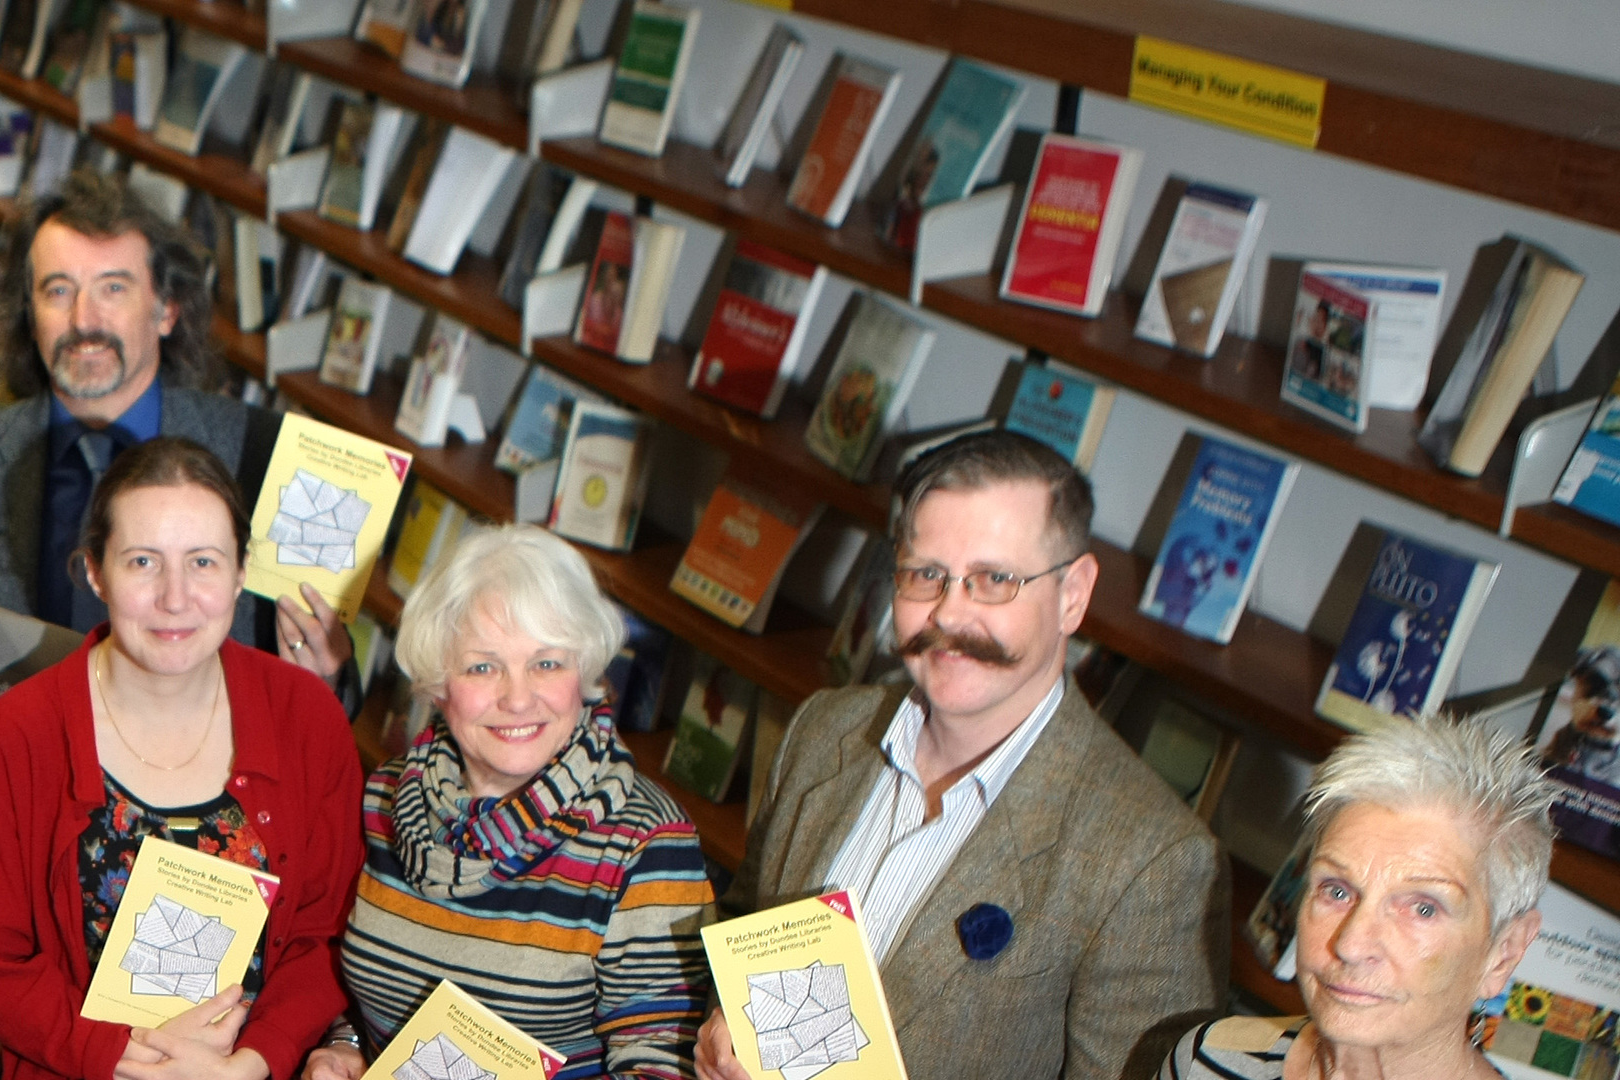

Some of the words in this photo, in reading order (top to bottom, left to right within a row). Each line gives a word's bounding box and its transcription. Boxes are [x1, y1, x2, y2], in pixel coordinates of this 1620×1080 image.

[1138, 56, 1204, 94] Managing
[1208, 72, 1240, 99] Your
[1243, 81, 1318, 118] Condition
[1197, 478, 1252, 512] Memory
[1380, 542, 1415, 574] ON
[1369, 563, 1439, 609] PLUTO
[157, 856, 207, 879] Patchwork
[208, 874, 254, 895] Memories
[725, 924, 780, 946] Patchwork
[781, 910, 832, 931] Memories
[731, 942, 758, 955] Stories
[759, 939, 769, 949] by
[769, 931, 798, 945] Dundee
[799, 922, 832, 937] Libraries
[747, 946, 778, 960] Creative
[779, 939, 806, 953] Writing
[806, 935, 821, 945] Lab
[448, 1003, 495, 1038] Patchwork
[493, 1034, 538, 1068] Memories
